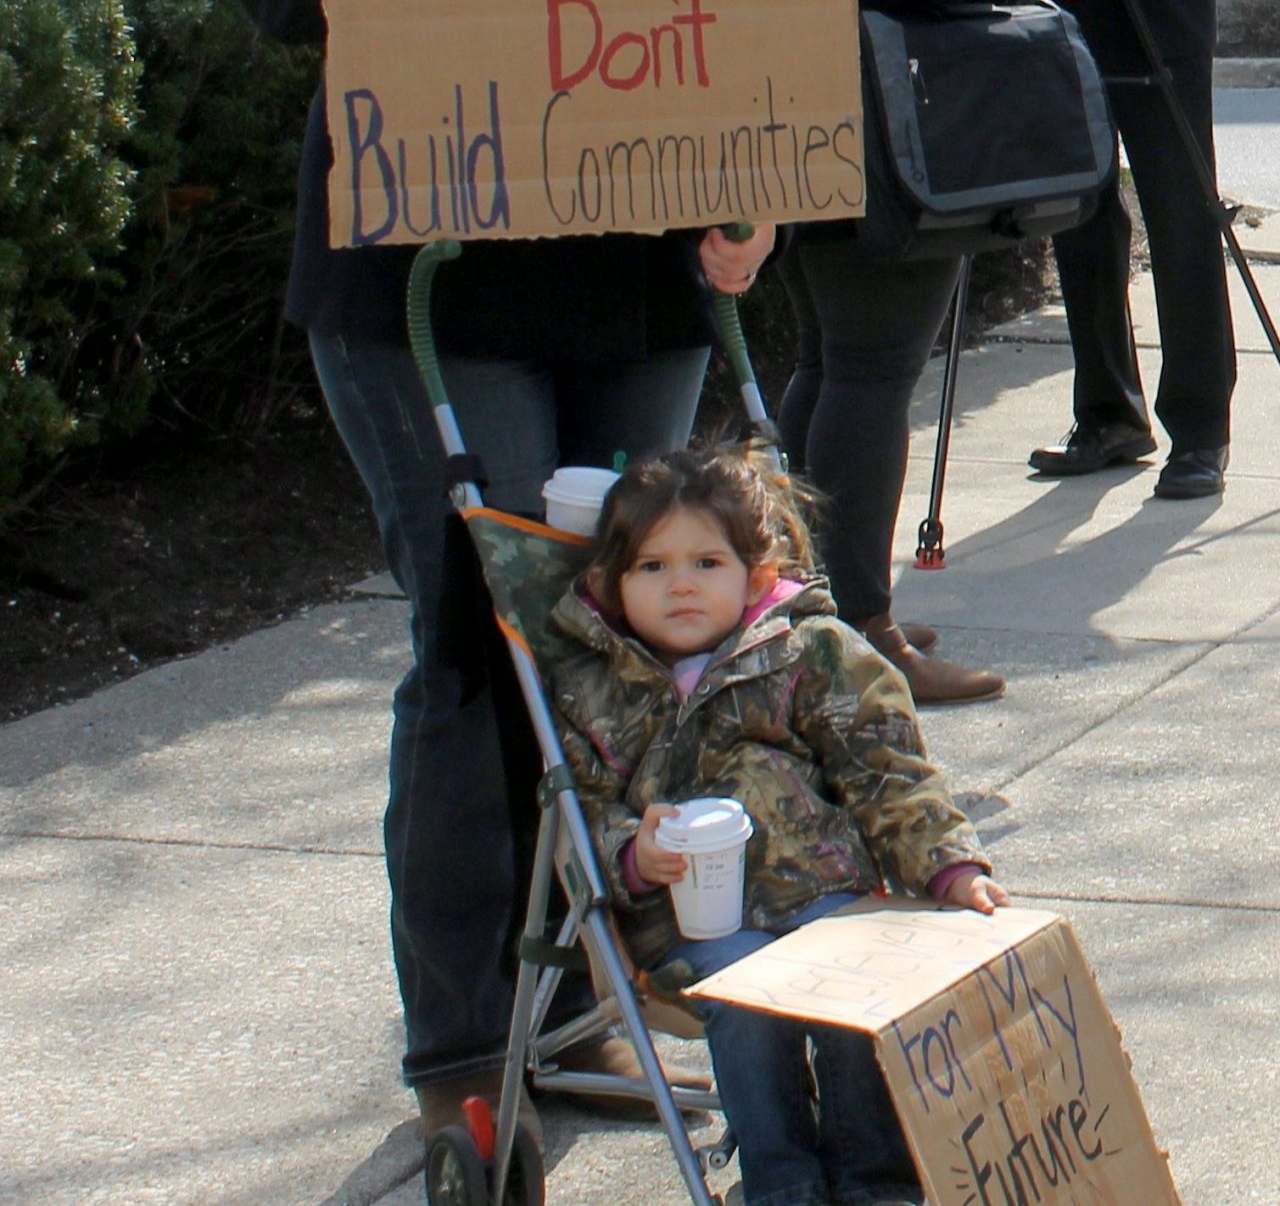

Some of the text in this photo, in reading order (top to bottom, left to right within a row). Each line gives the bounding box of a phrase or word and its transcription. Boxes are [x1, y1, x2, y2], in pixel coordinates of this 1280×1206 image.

[344, 76, 865, 246] Build Communities
[962, 943, 1091, 1107] My
